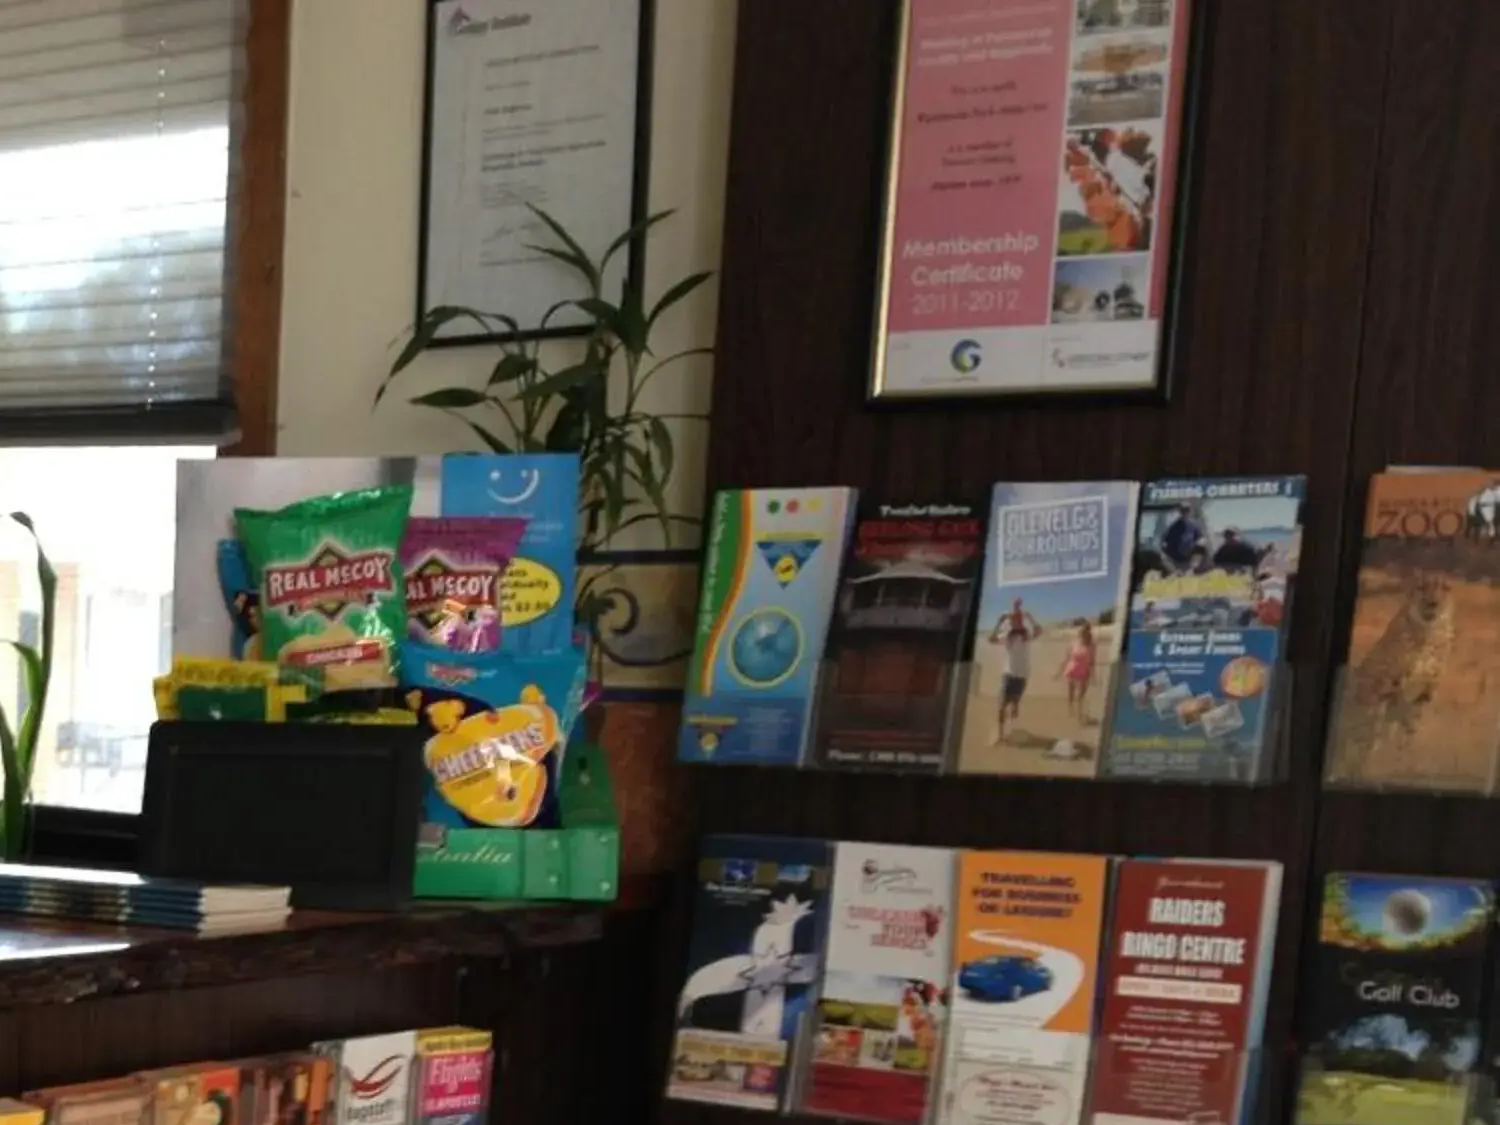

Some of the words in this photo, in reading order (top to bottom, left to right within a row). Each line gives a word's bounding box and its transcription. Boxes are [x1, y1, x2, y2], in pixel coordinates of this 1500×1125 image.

[902, 230, 1040, 259] Membership
[910, 260, 1024, 287] Certificate
[1376, 510, 1463, 538] ZOO
[270, 567, 317, 599] REAL
[1149, 897, 1226, 927] RAIDERS
[1121, 930, 1177, 959] BINGO
[1179, 934, 1247, 964] CENTRE
[1358, 980, 1402, 1003] Golf
[1408, 985, 1461, 1009] Club
